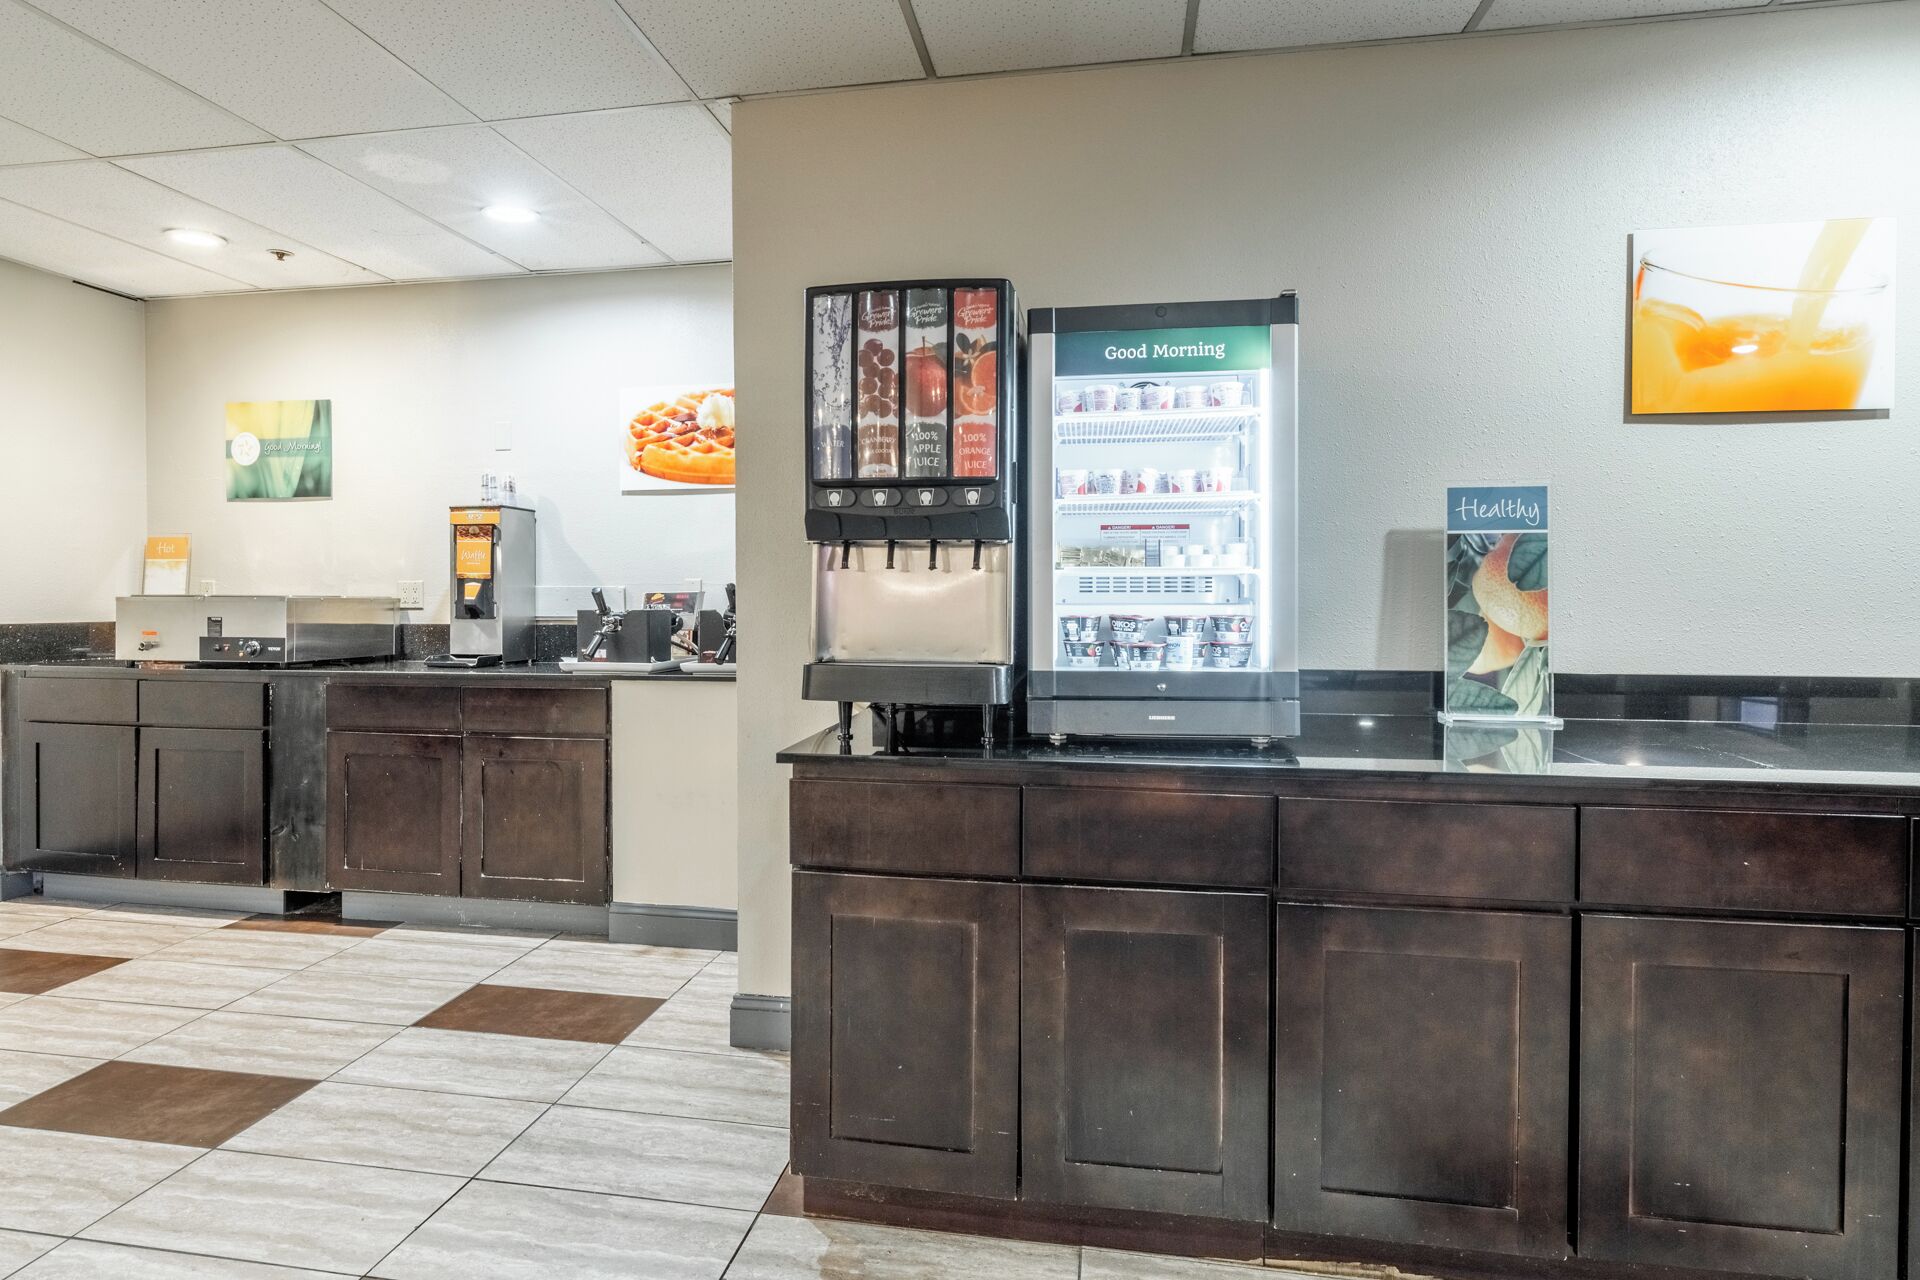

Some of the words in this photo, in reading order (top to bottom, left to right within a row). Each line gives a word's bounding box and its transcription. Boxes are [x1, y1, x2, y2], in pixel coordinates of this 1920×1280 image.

[914, 313, 938, 326] Pride
[963, 315, 987, 326] Pride
[1104, 344, 1147, 359] Good
[1152, 341, 1226, 359] Morning
[914, 432, 939, 442] 100%
[962, 433, 987, 443] 100%
[264, 442, 282, 455] Good
[820, 440, 845, 448] WATER
[912, 444, 942, 454] APPLE
[958, 447, 992, 456] ORANGE
[913, 457, 940, 468] JUICE
[964, 460, 988, 470] JUICE
[1455, 496, 1540, 526] Healthy
[157, 542, 175, 554] Hot
[461, 549, 486, 560] Waffle
[1111, 620, 1136, 629] OIKOS
